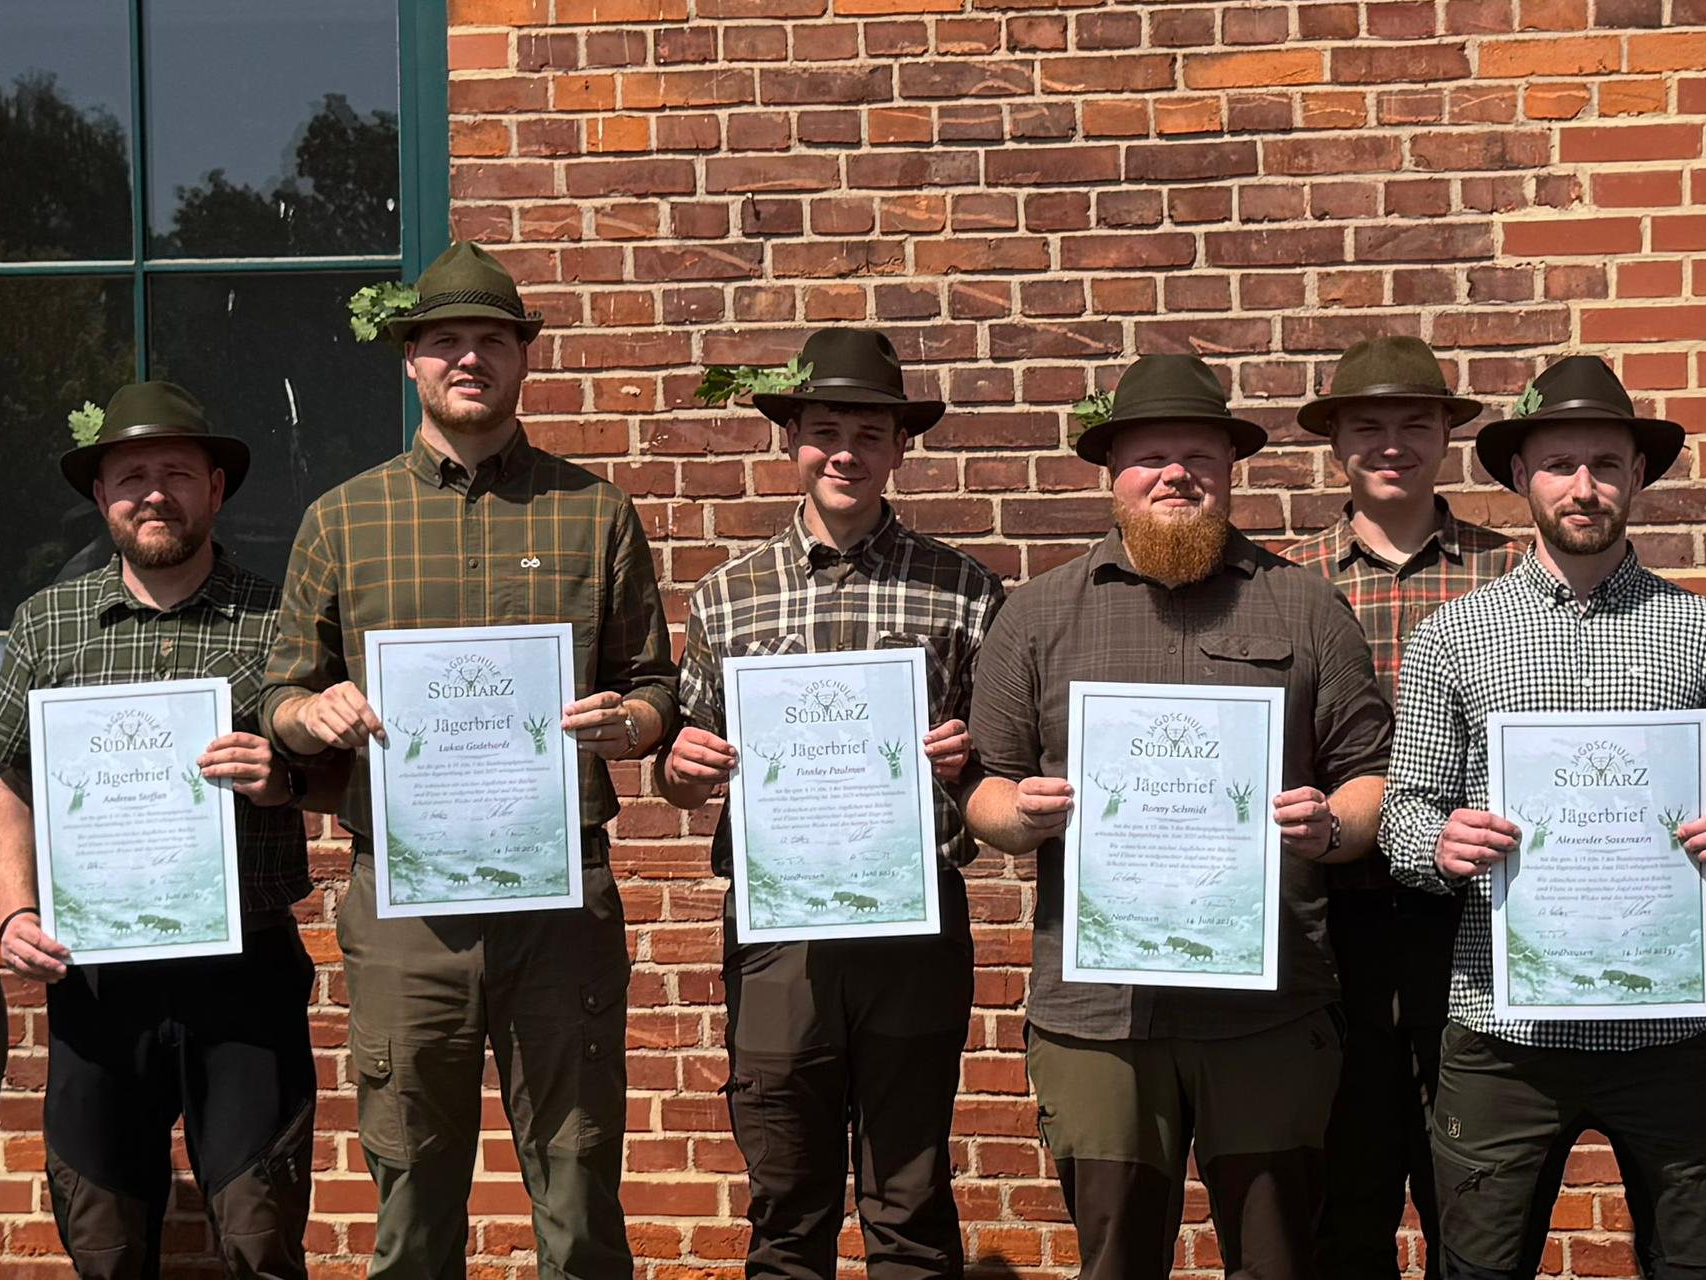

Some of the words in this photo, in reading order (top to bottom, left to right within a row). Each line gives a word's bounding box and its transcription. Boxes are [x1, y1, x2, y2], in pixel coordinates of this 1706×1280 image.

[428, 678, 514, 699] SÜDHARZ
[798, 679, 856, 705] JAGDSCHULE
[785, 703, 869, 724] SÜDHARZ
[433, 714, 514, 735] Jägerbrief
[1146, 712, 1207, 738] JAGDSCHULE
[89, 731, 173, 753] SÜDHARZ
[791, 740, 868, 760] Jägerbrief
[1130, 738, 1220, 759] SÜDHARZ
[1570, 740, 1636, 767] JAGDSCHULE
[96, 766, 172, 787] Jägerbrief
[1133, 777, 1217, 796] Jägerbrief
[1554, 767, 1650, 787] SÜDHARZ
[1171, 804, 1207, 814] Schmidt
[1559, 807, 1647, 827] Jägerbrief
[1555, 835, 1602, 845] Alexander
